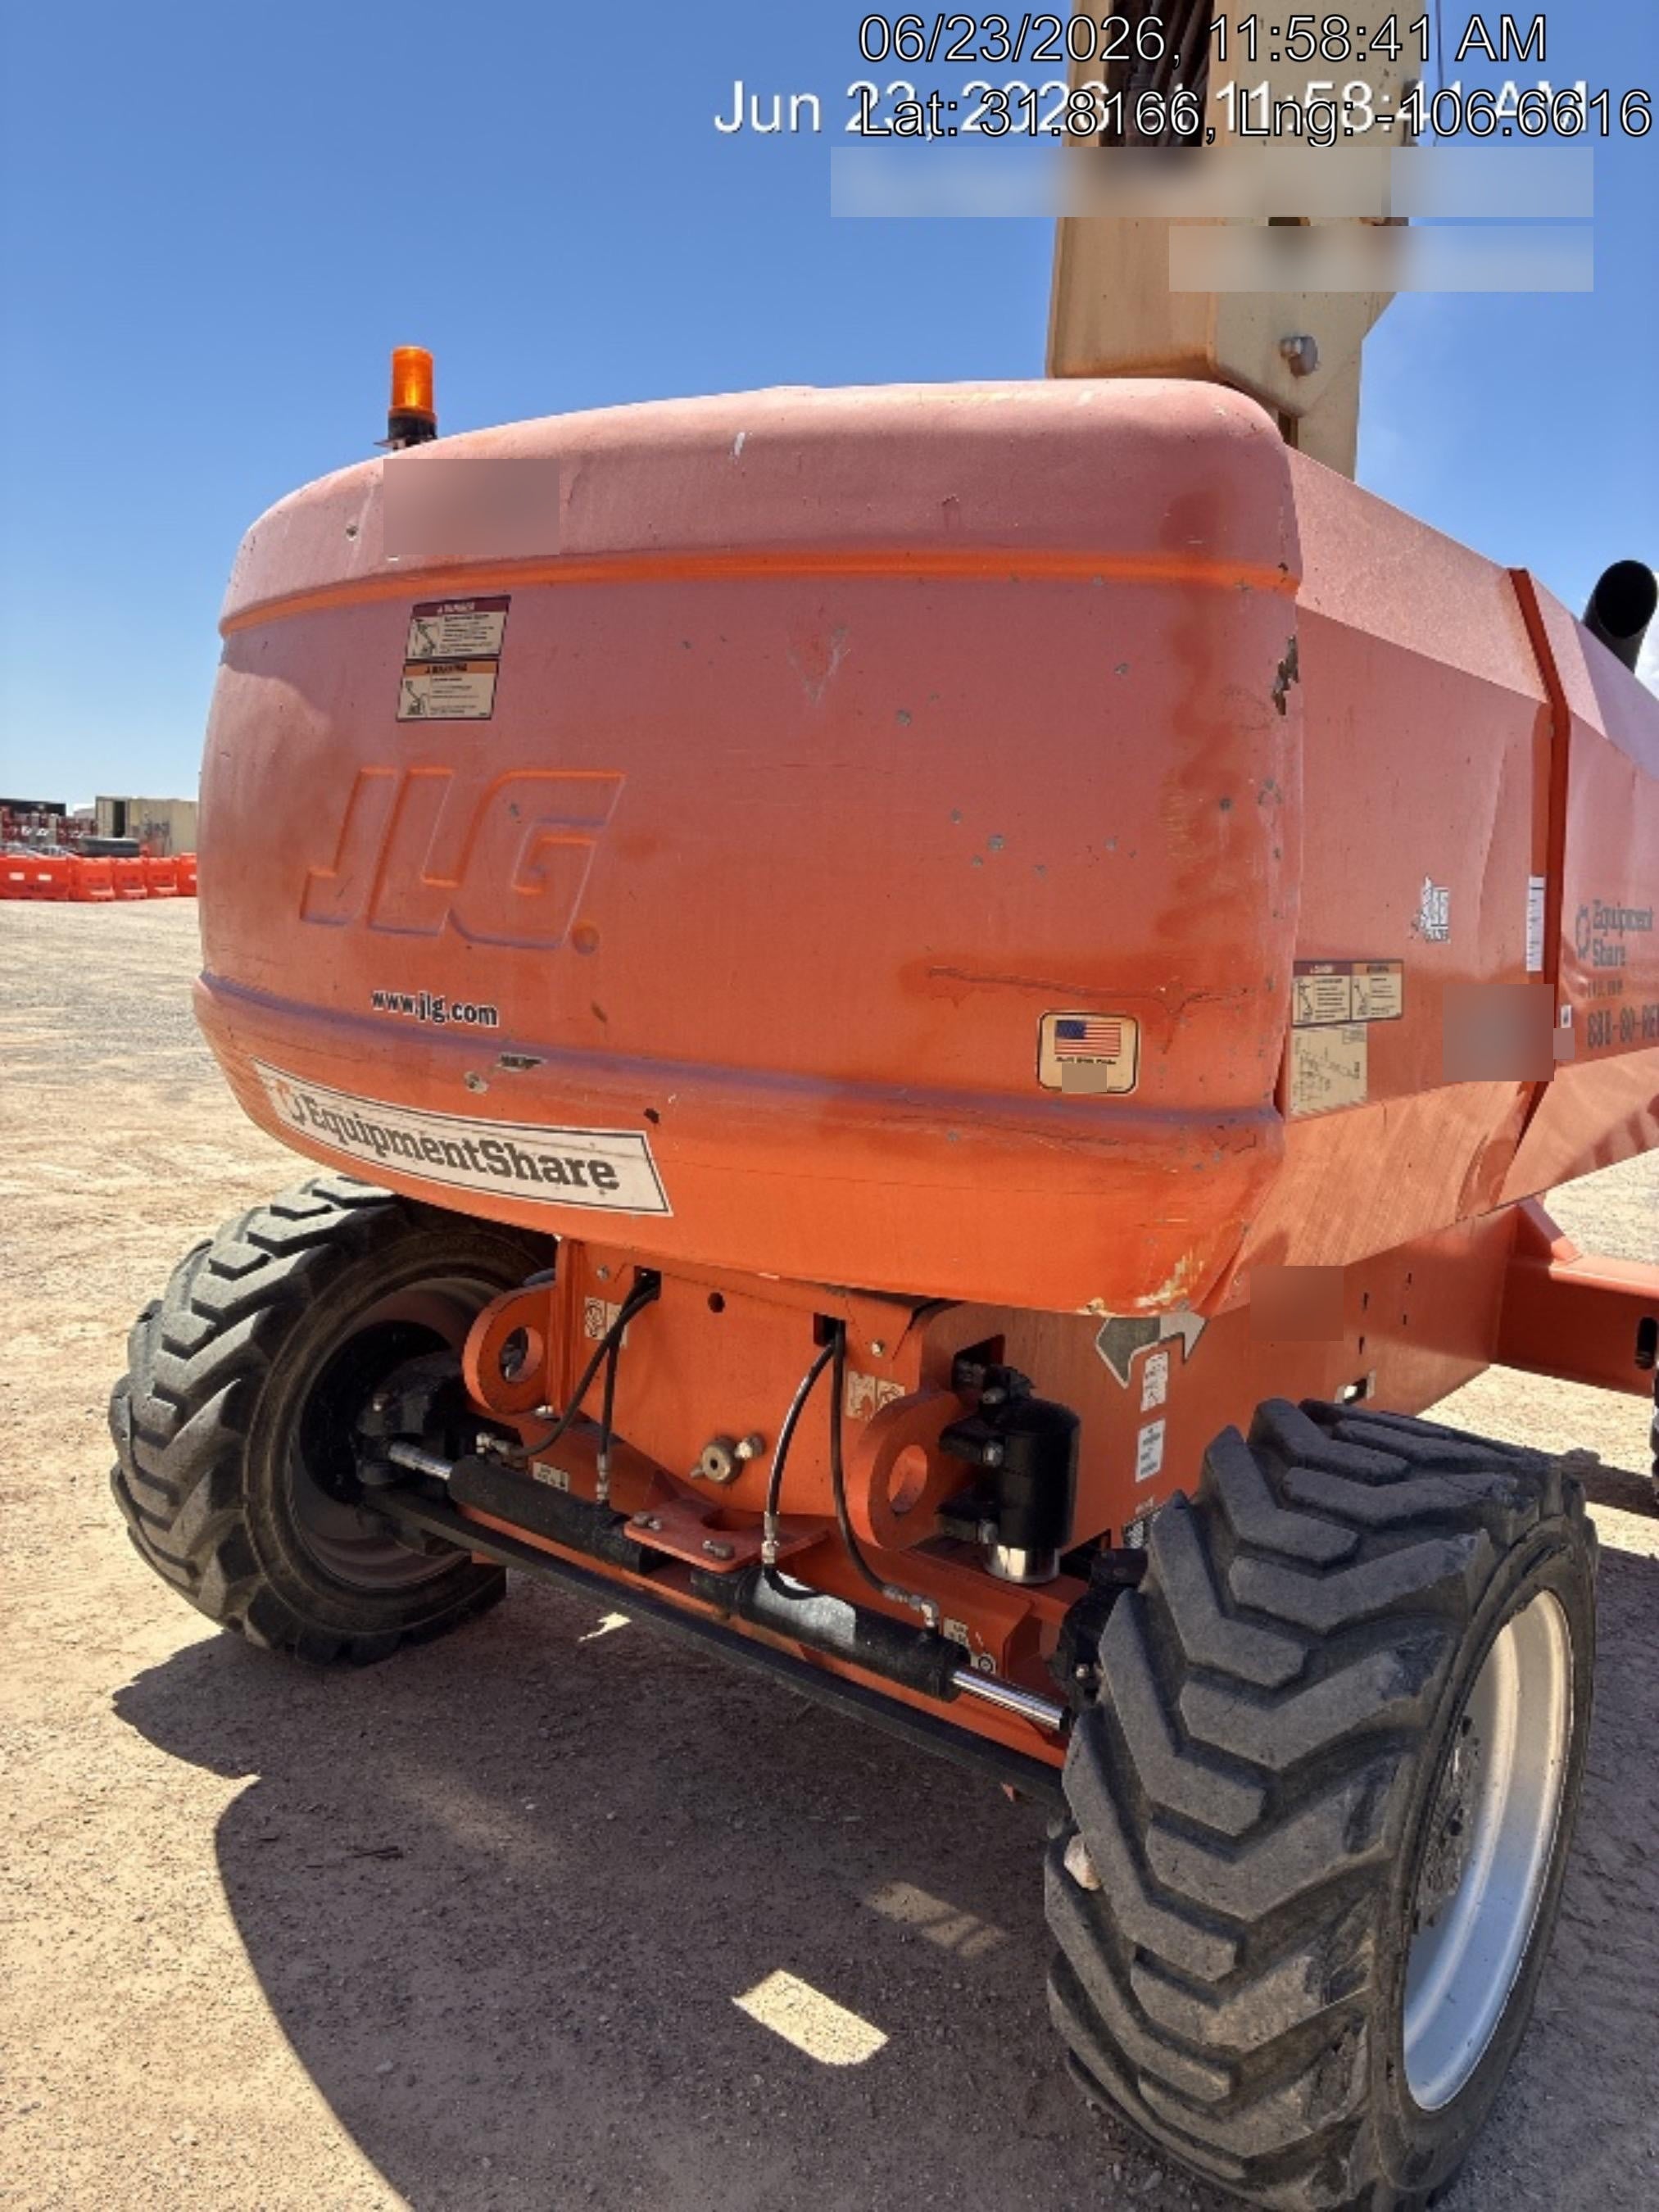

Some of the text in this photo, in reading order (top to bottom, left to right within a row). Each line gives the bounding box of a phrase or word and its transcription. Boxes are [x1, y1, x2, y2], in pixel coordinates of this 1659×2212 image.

[299, 765, 628, 950] JLG
[1592, 939, 1626, 968] Share
[371, 990, 499, 1027] www.jlg.com
[302, 1094, 621, 1191] EquipmentShare
